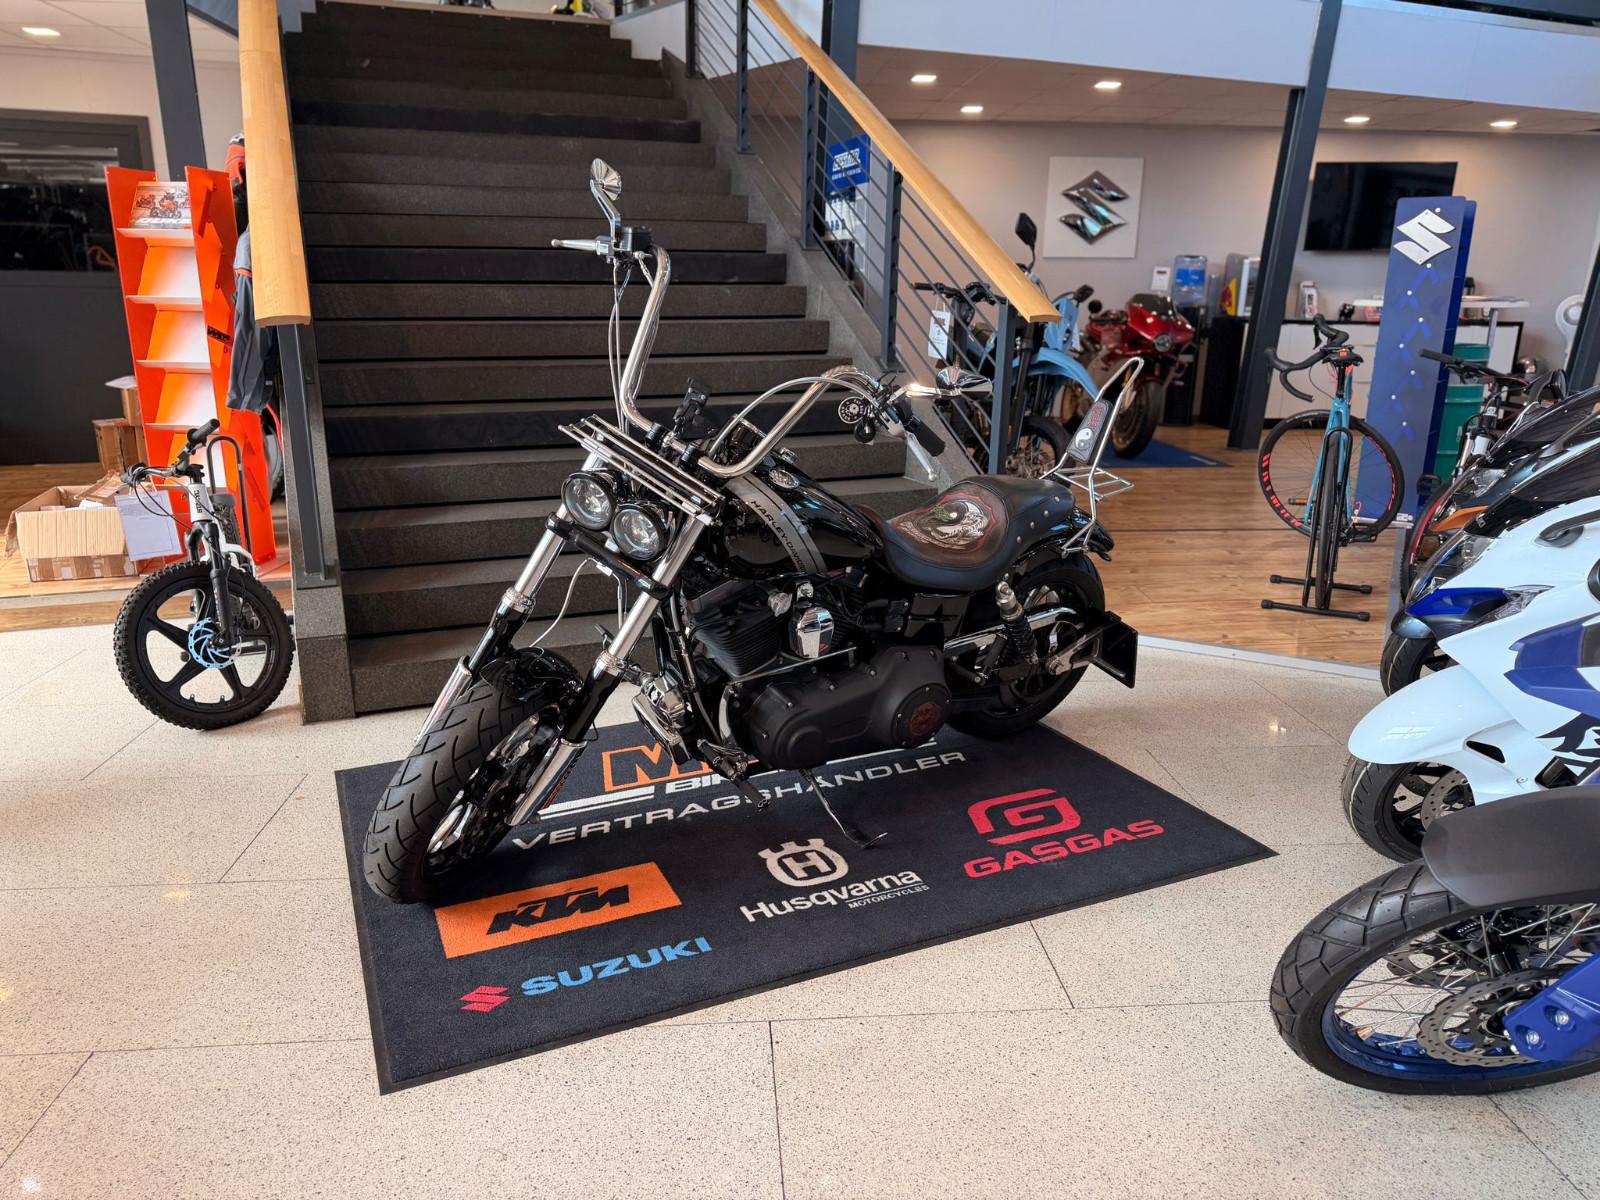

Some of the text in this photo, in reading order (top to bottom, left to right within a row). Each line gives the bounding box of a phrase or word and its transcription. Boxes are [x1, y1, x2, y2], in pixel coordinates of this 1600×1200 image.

[963, 819, 1165, 879] GASGAS
[486, 885, 630, 936] KTM
[739, 870, 923, 924] Husqvarna
[848, 884, 930, 909] MOTORCYCLES
[520, 936, 713, 997] SUZUKI
